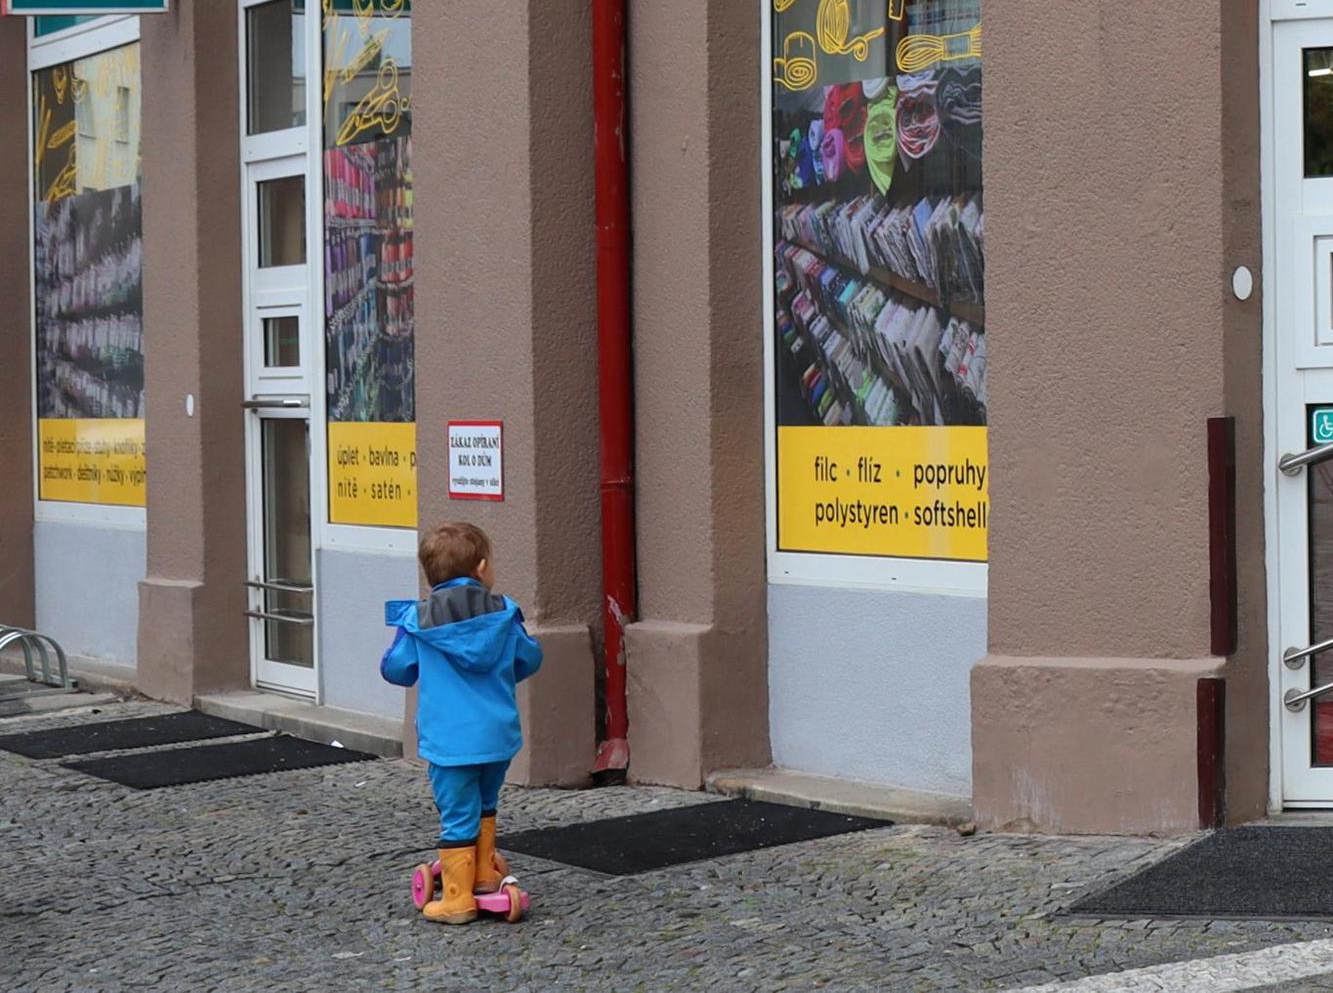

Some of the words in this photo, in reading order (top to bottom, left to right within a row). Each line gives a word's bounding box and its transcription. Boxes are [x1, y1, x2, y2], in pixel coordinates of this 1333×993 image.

[451, 433, 471, 448] ZÁKAZ
[473, 433, 500, 449] OPÍRANÍ
[337, 445, 359, 469] úplet
[369, 445, 399, 467] bavlna
[458, 454, 471, 467] KOL
[471, 454, 477, 467] O
[477, 451, 492, 467] DŮM
[815, 456, 837, 482] filc
[858, 457, 882, 483] flíz
[914, 459, 986, 491] popruhy
[337, 477, 358, 498] nitě
[371, 478, 401, 500] satén
[815, 497, 898, 528] polystyren
[914, 499, 986, 528] softshell
